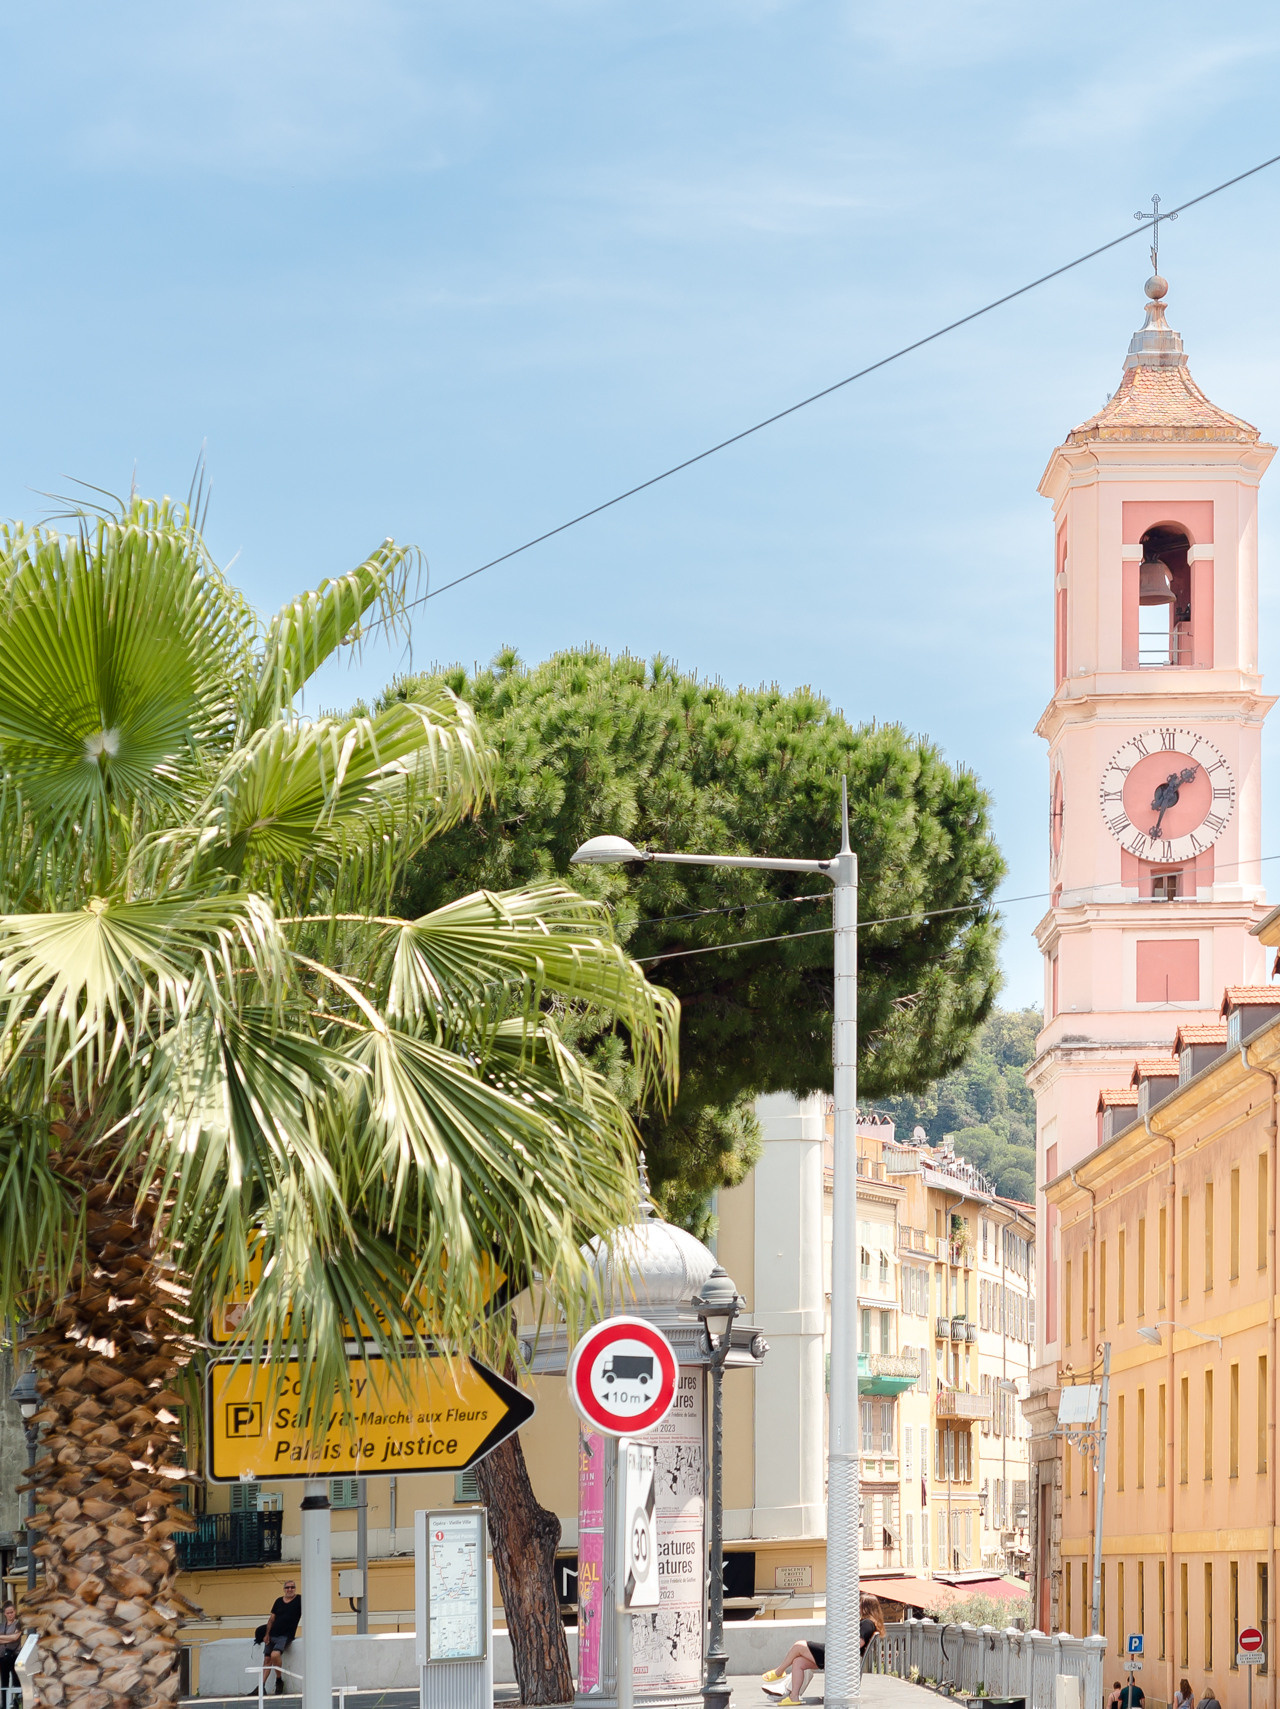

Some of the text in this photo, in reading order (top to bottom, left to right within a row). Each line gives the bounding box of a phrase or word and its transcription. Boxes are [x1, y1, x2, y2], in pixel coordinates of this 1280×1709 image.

[1132, 739, 1150, 759] XI
[1160, 733, 1175, 751] XII
[1213, 787, 1231, 800] III
[417, 1412, 442, 1424] aux
[445, 1409, 488, 1422] Fleurs
[660, 1424, 676, 1432] 2023
[274, 1434, 458, 1463] Palais de justice
[634, 1528, 647, 1561] 30
[659, 1591, 675, 1599] 2023
